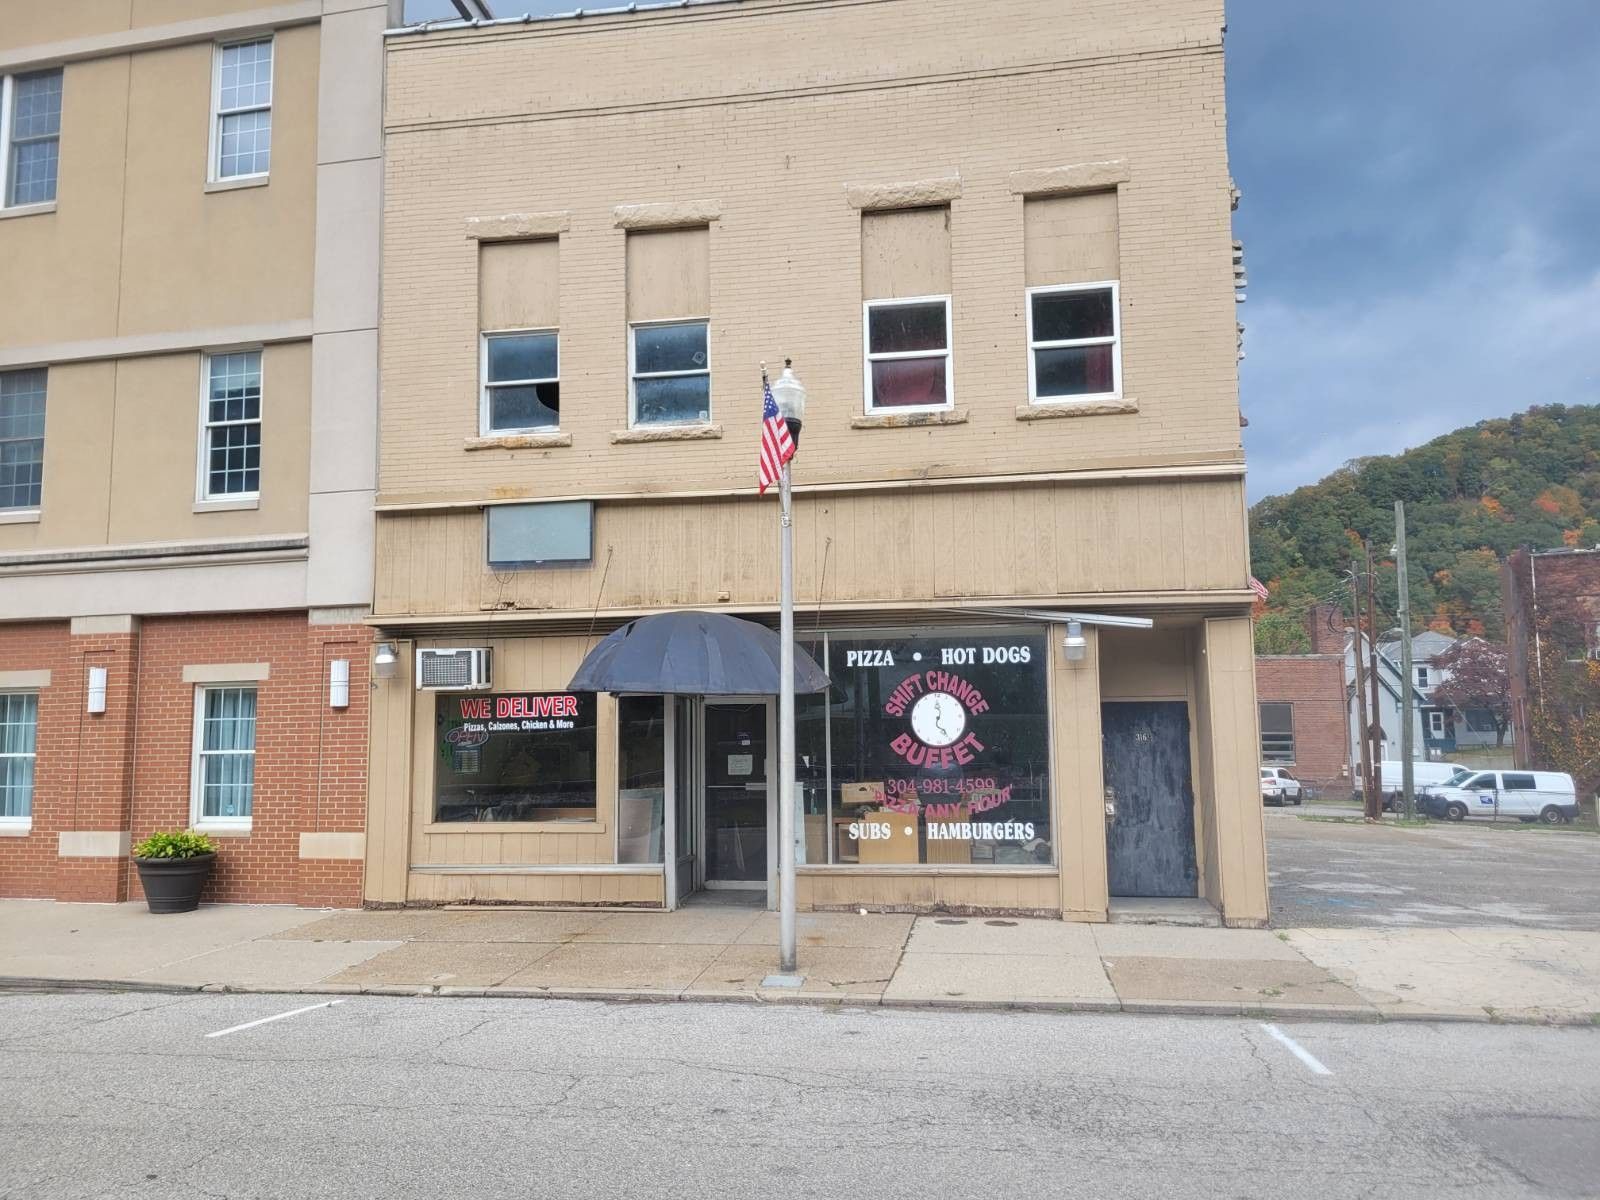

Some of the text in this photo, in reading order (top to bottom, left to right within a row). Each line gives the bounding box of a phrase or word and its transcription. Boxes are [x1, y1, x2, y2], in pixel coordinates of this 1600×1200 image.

[847, 650, 894, 667] PIZZA
[942, 646, 1031, 665] HOT DOGS
[885, 670, 991, 718] SHIFT CHANGE
[460, 695, 578, 719] WE DELIVER
[463, 719, 574, 733] Pizzas, Calzones, Chicken & More
[889, 731, 985, 769] BUFFET
[887, 778, 996, 795] 304-981-4599
[925, 803, 962, 818] ANY
[848, 822, 1035, 840] SUBS HAMBURGERS
